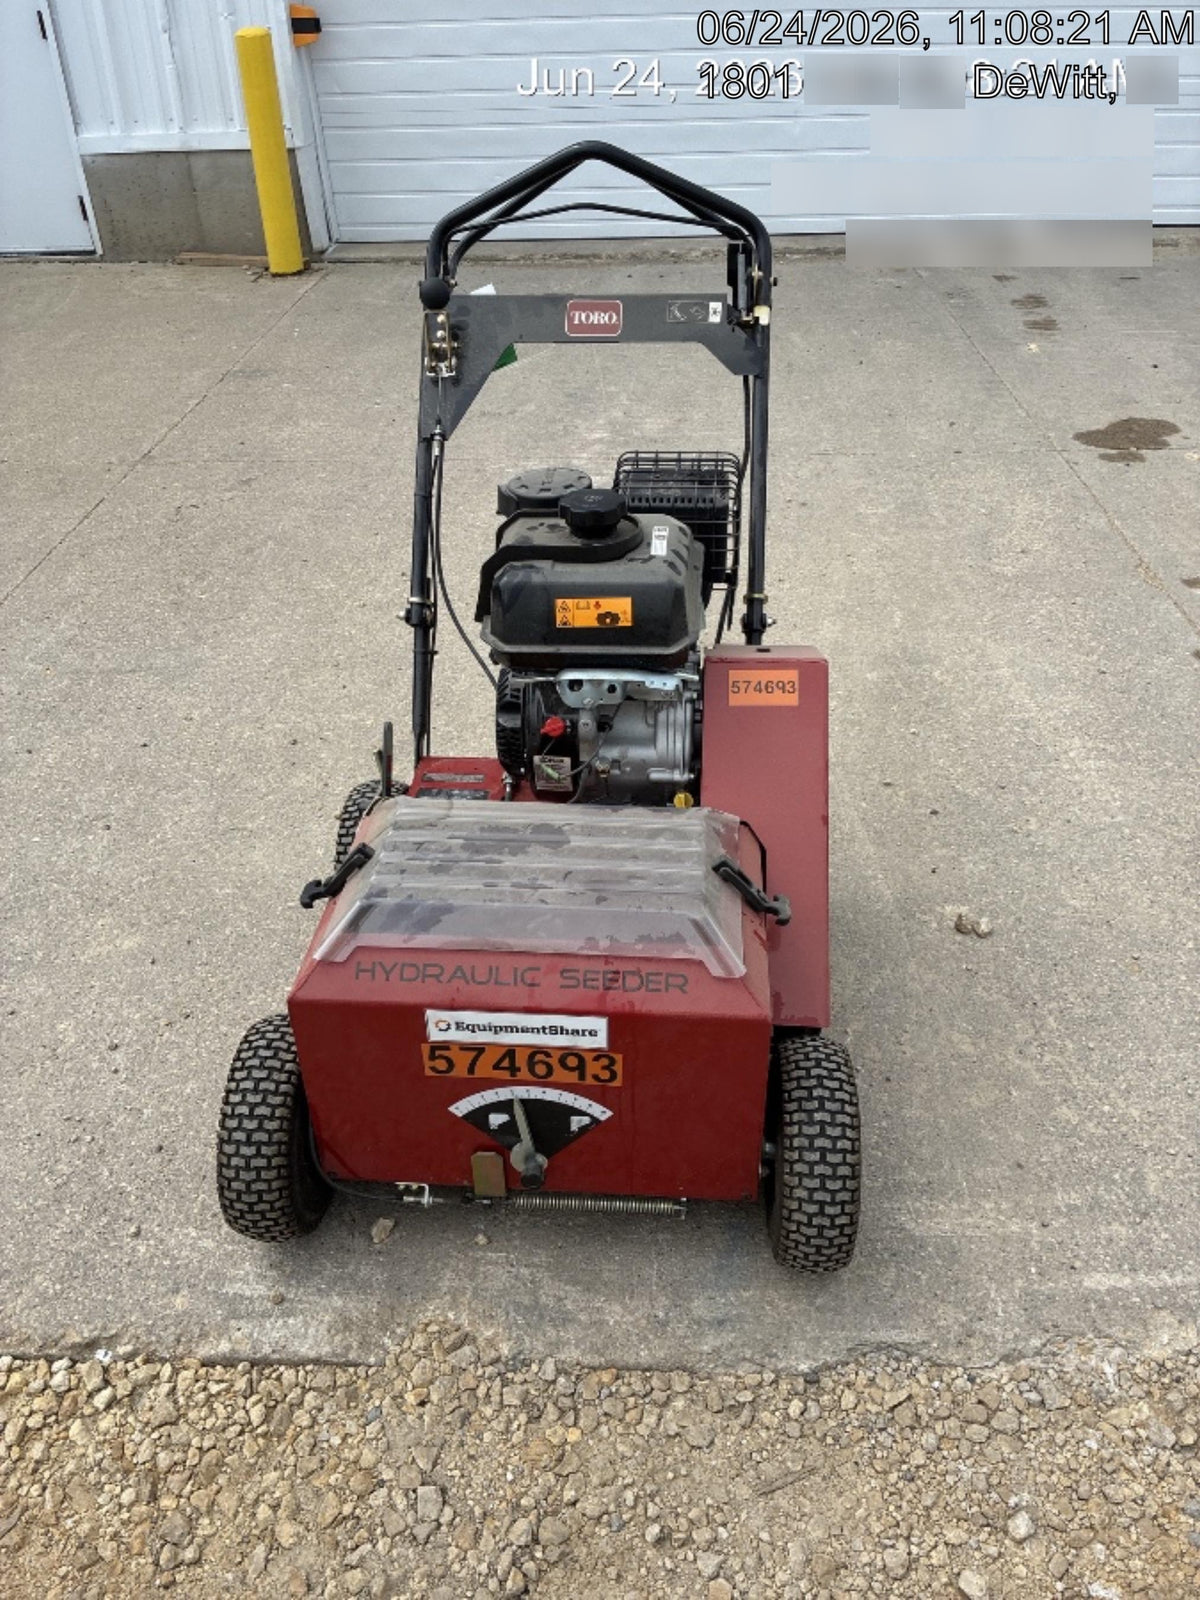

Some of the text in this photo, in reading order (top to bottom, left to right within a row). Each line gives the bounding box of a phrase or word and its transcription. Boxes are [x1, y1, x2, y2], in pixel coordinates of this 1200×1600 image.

[570, 310, 618, 325] TORO
[730, 680, 797, 695] 574693
[354, 960, 690, 994] HYDRAULIC SEEDER
[454, 1020, 599, 1038] EquipmentShare
[427, 1045, 619, 1083] 574693
